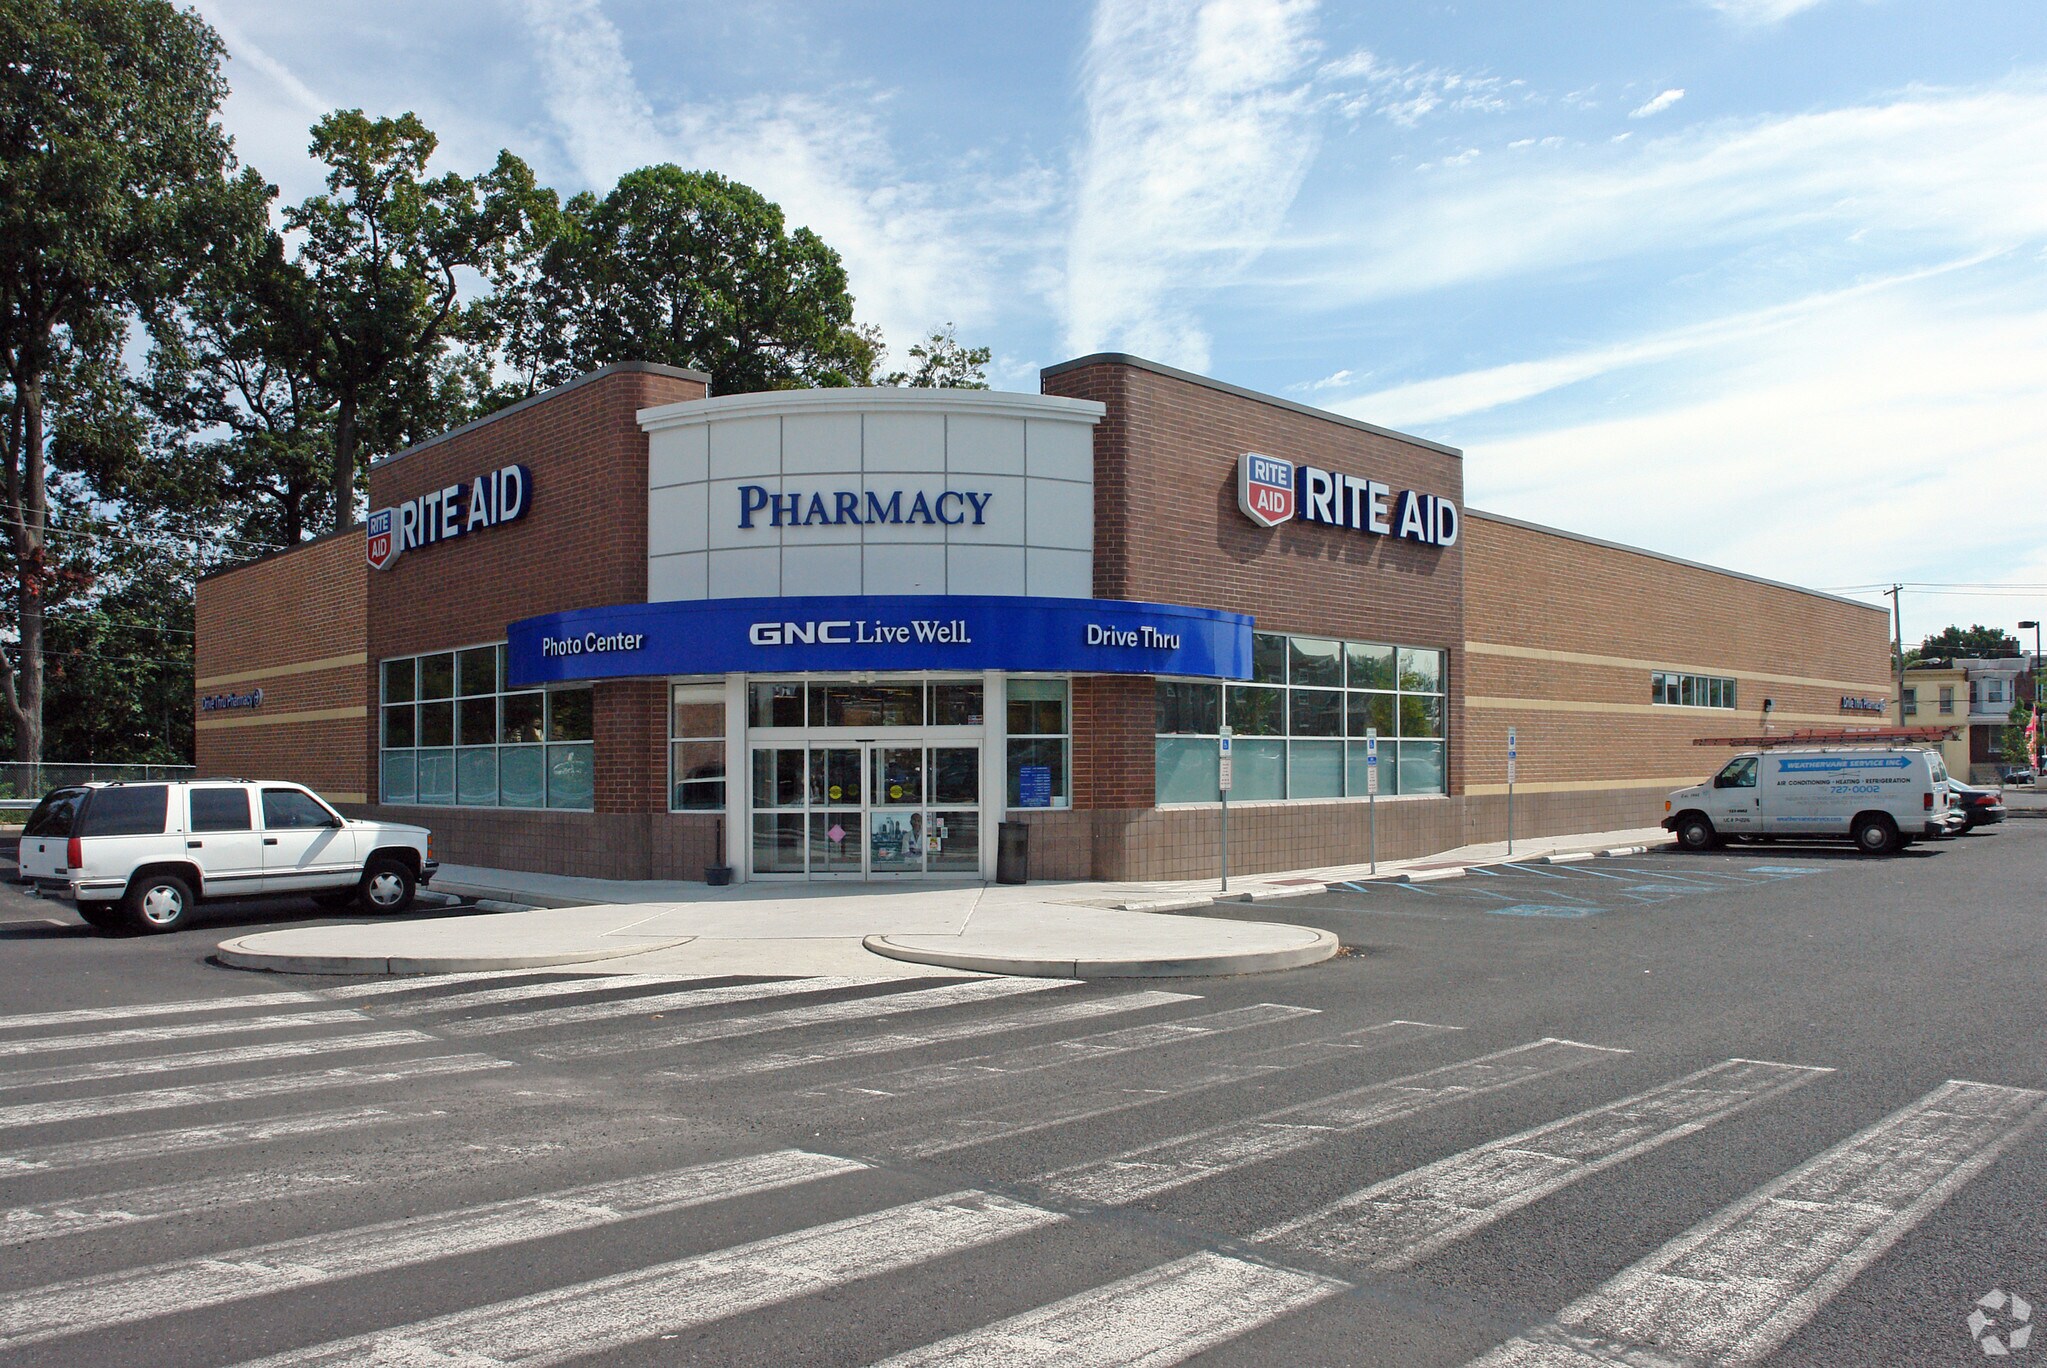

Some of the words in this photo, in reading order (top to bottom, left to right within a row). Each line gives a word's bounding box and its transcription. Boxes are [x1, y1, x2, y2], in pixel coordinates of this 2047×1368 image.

[1254, 460, 1287, 485] RITE
[400, 484, 459, 551] RITE
[467, 464, 524, 532] AID
[737, 485, 993, 529] PHARMACY
[1257, 489, 1285, 513] AID
[1304, 466, 1390, 535] RITE
[1399, 490, 1458, 547] AID
[370, 513, 389, 534] RITE
[371, 538, 387, 559] AID
[542, 637, 582, 657] Photo
[585, 632, 644, 653] Center
[749, 621, 851, 646] GNC
[855, 620, 910, 643] Live
[911, 620, 972, 644] Well.
[1087, 624, 1138, 647] Drive
[1140, 626, 1180, 649] Thru
[1787, 760, 1848, 769] WEATHERVANE
[1849, 759, 1884, 768] SERVICE
